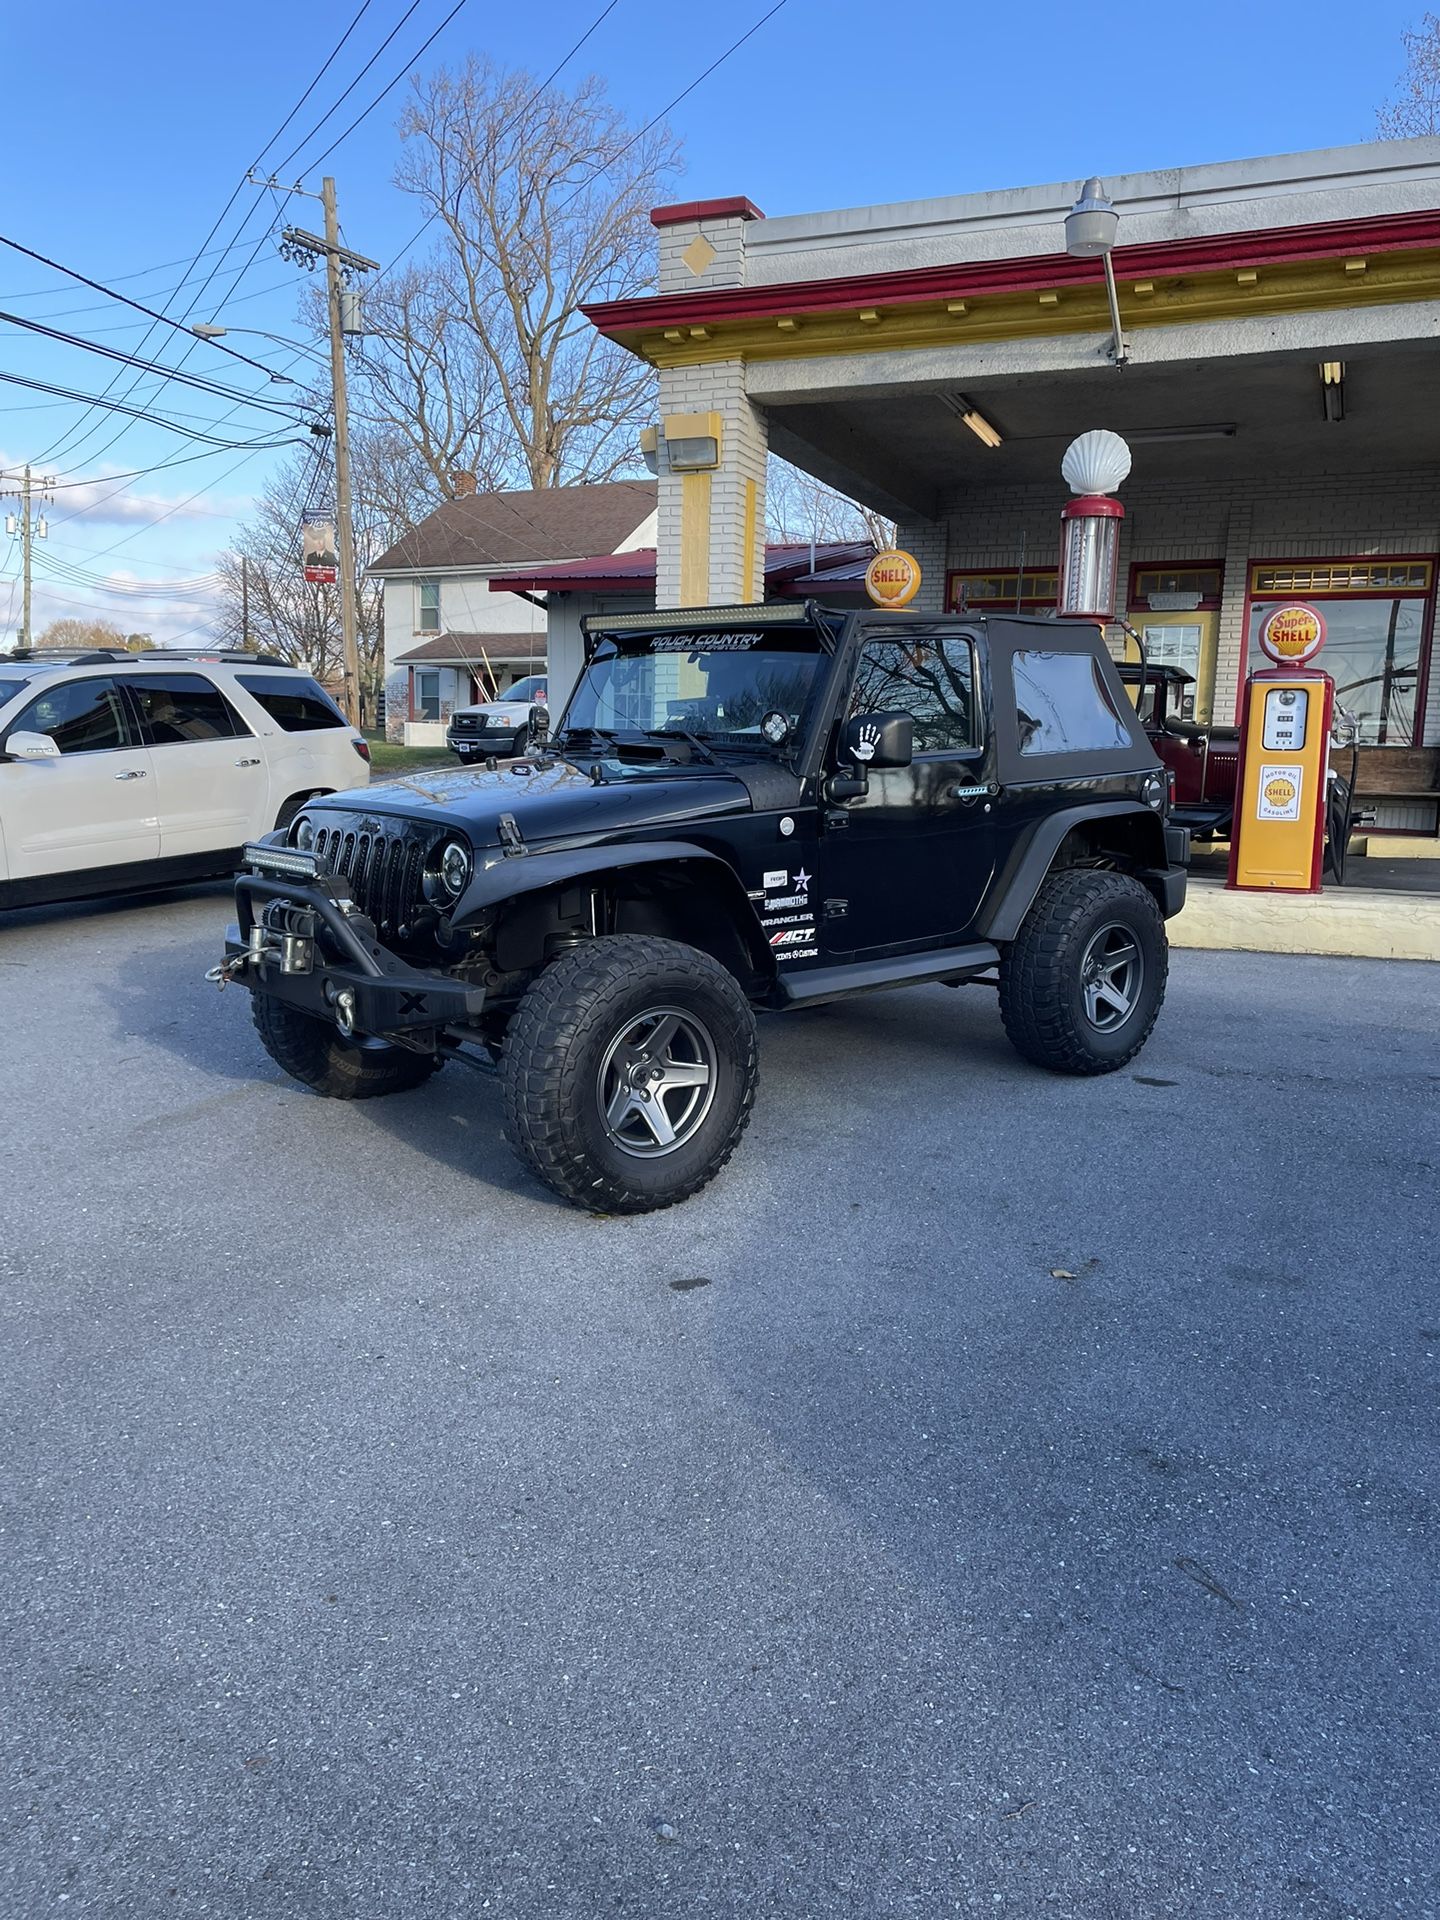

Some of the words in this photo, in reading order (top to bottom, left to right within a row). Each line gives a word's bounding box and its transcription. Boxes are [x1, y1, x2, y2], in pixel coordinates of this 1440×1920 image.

[874, 569, 907, 583] SHELL
[649, 635, 695, 648] ROUGH
[695, 633, 764, 646] COUNTRY
[1272, 630, 1311, 642] SHELL
[1265, 771, 1287, 779] MOTOR
[1268, 788, 1291, 796] SHELL
[1264, 807, 1294, 816] GASOLINE
[776, 927, 816, 944] ACT
